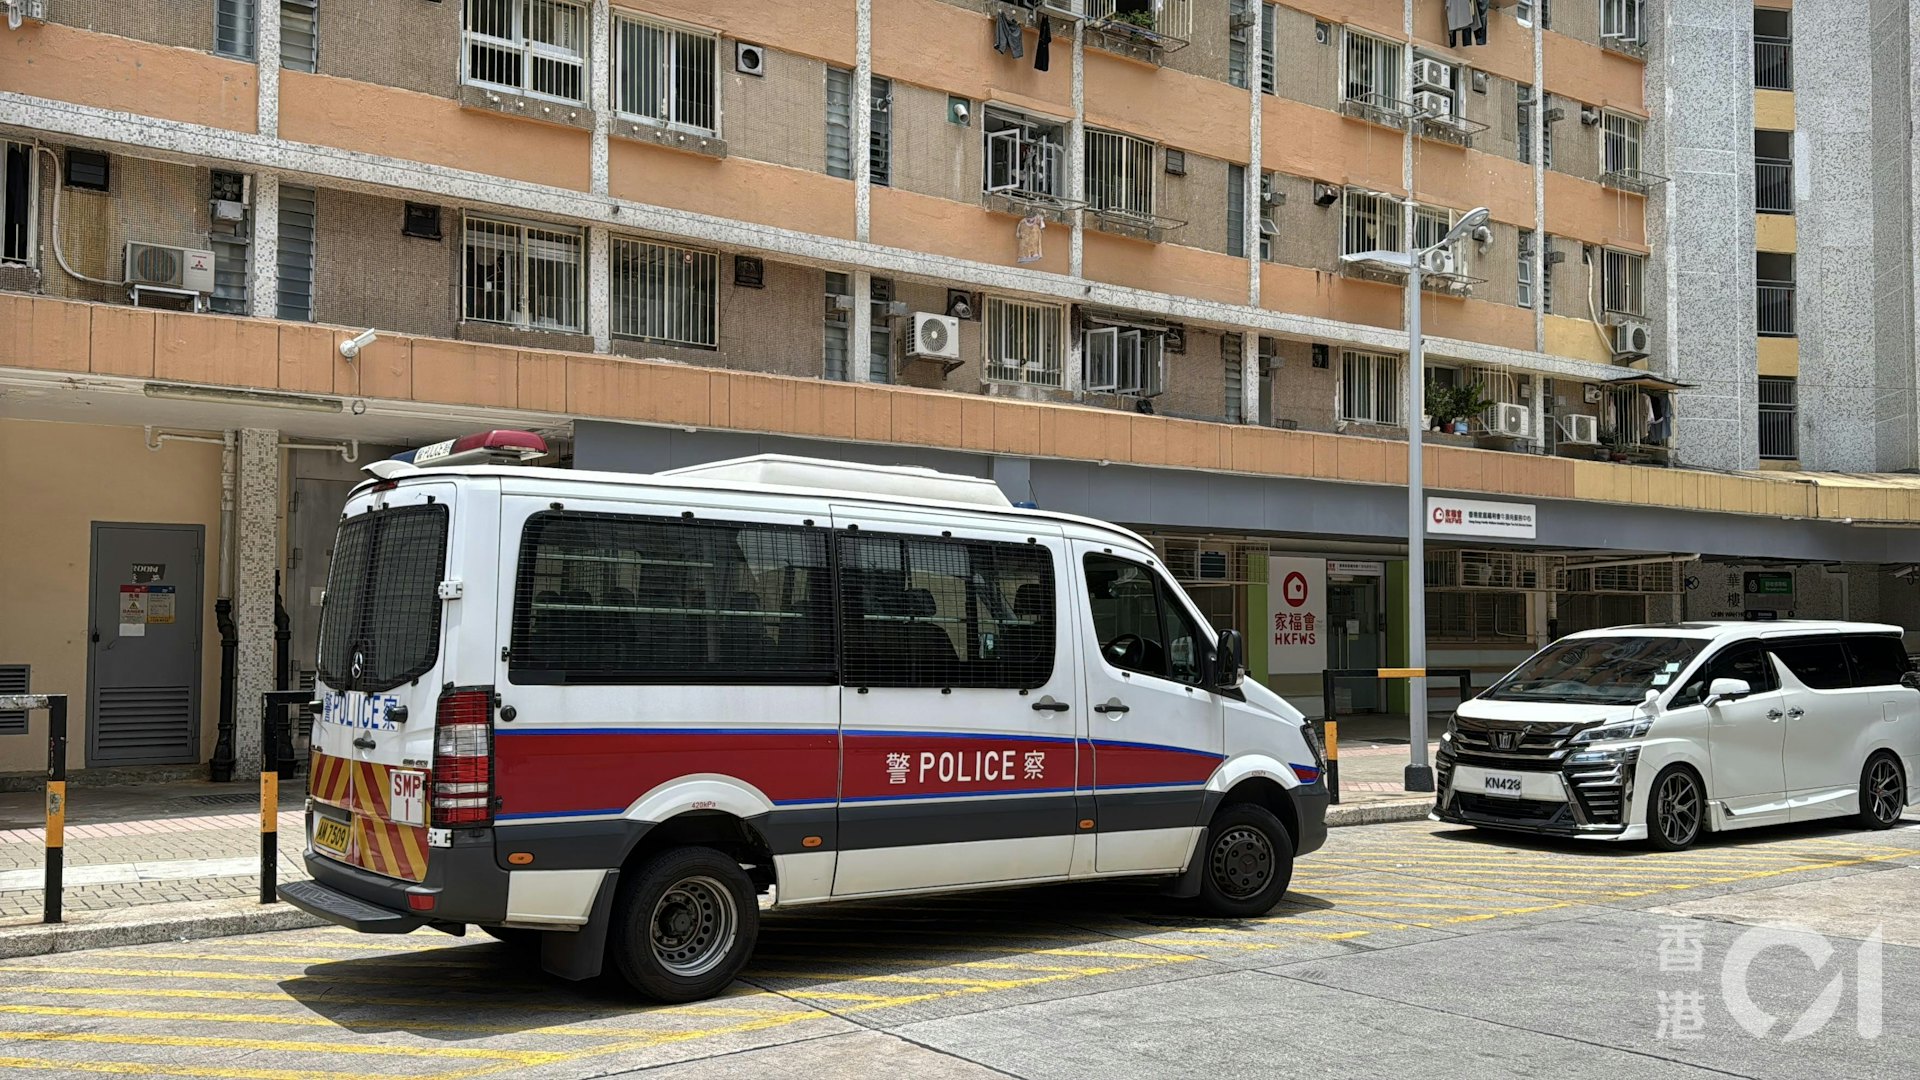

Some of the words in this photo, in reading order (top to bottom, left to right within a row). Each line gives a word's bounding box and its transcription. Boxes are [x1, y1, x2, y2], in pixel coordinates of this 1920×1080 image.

[1275, 612, 1316, 631] 家福會
[1275, 633, 1316, 645] HKFWS
[333, 692, 381, 729] POLICE
[886, 752, 911, 784] 警
[919, 750, 1016, 783] POLICE
[1023, 750, 1045, 780] 察
[394, 774, 421, 798] SMP
[405, 798, 409, 821] 1
[326, 824, 346, 847] 7509
